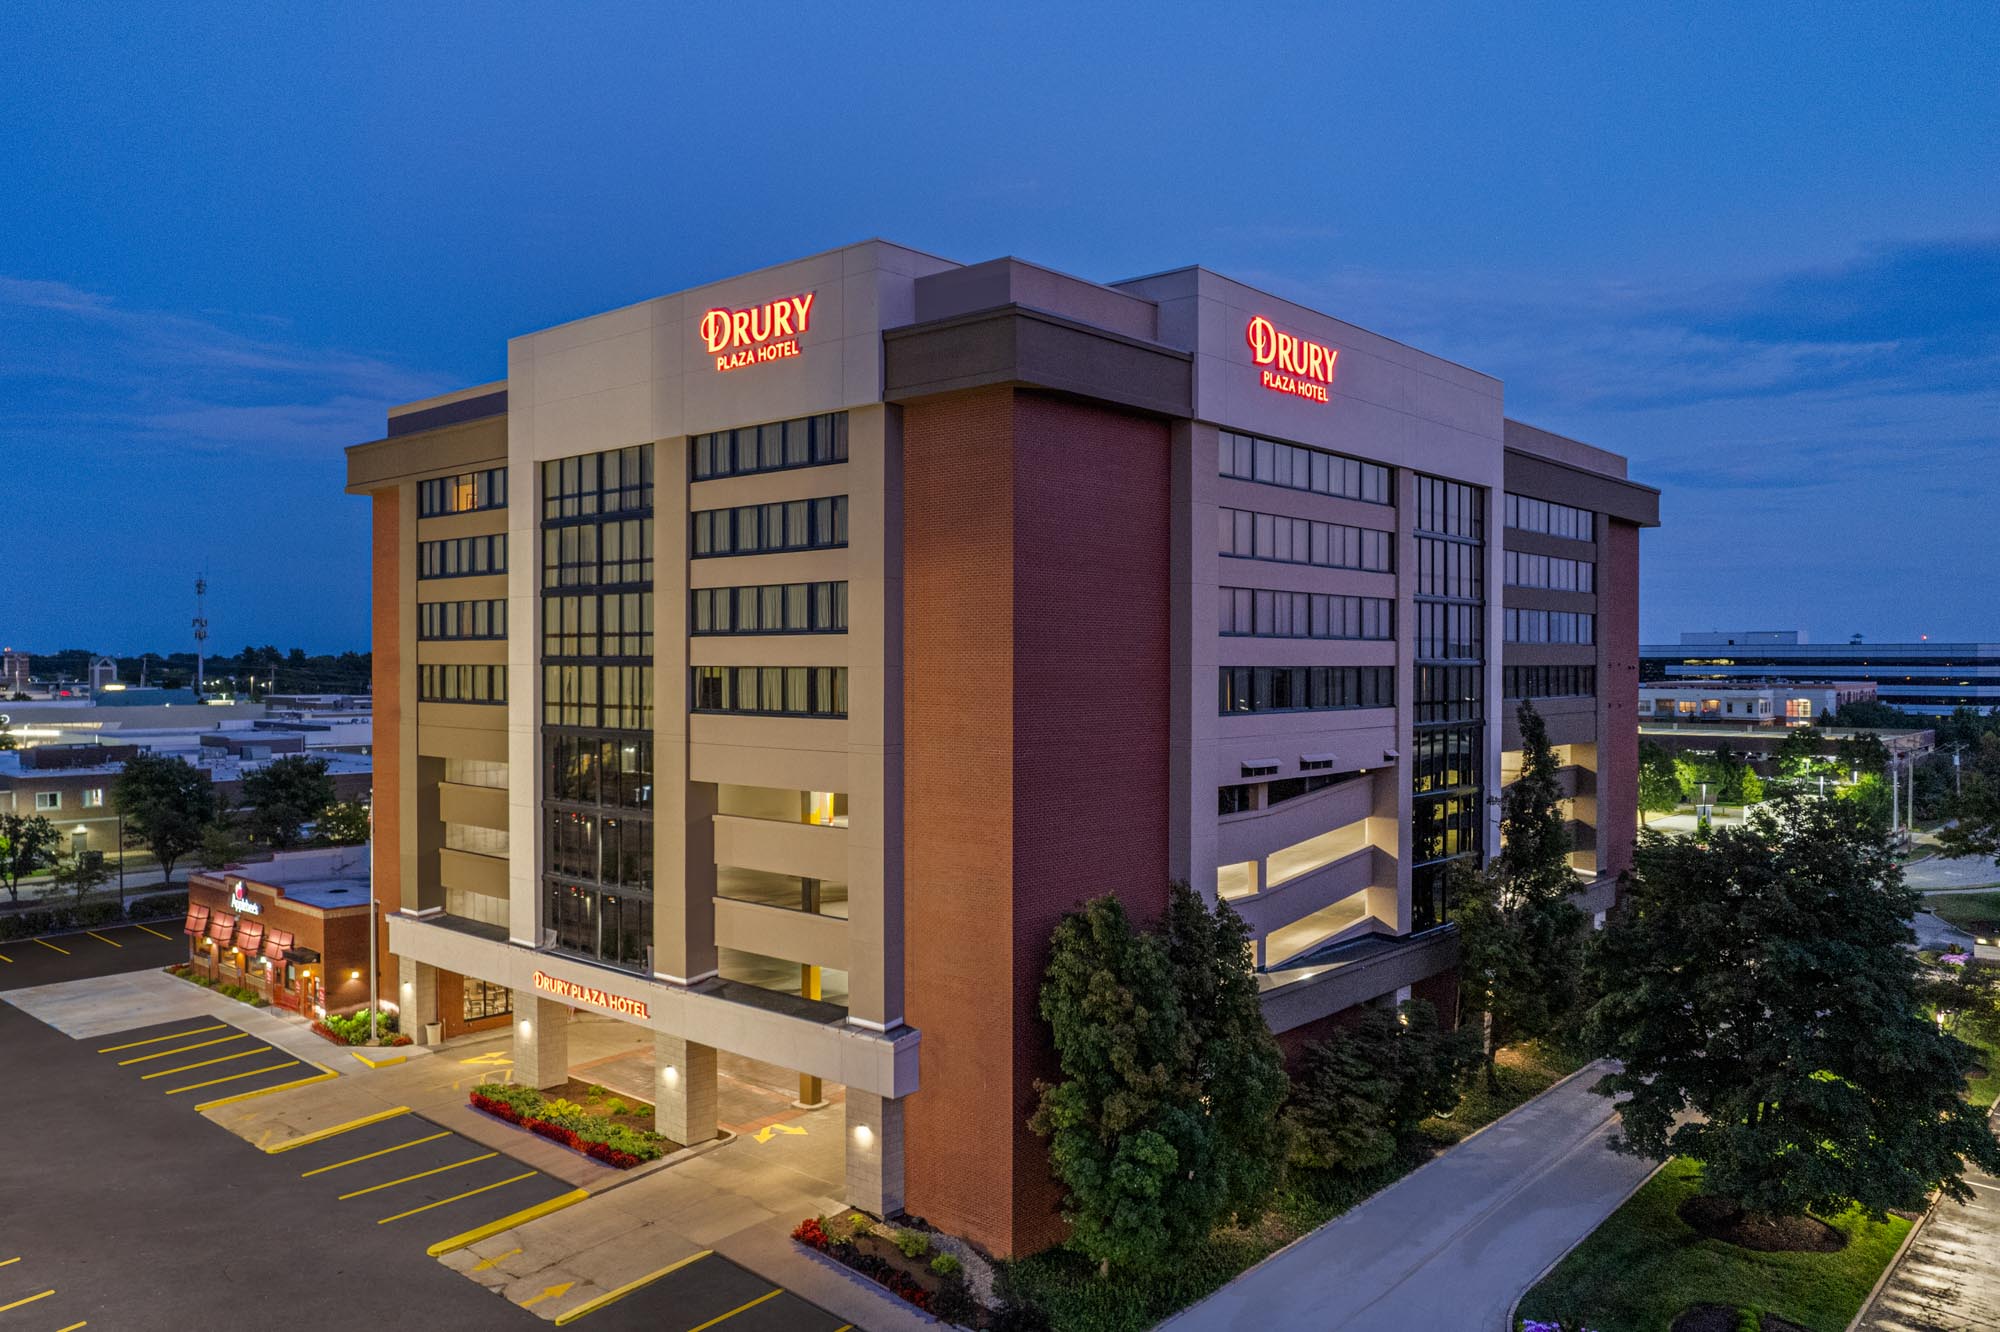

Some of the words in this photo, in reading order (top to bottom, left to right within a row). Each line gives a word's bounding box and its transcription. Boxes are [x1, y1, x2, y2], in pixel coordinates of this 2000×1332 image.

[700, 293, 813, 353] DRURY
[716, 349, 755, 371] PLAZA
[757, 340, 799, 362] HOTEL
[1248, 315, 1338, 383] DRURY
[1263, 370, 1296, 393] PLAZA
[1297, 380, 1329, 402] HOTEL
[533, 970, 569, 996] DRURY
[571, 984, 607, 1008] PLAZA
[609, 995, 649, 1020] HOTEL
